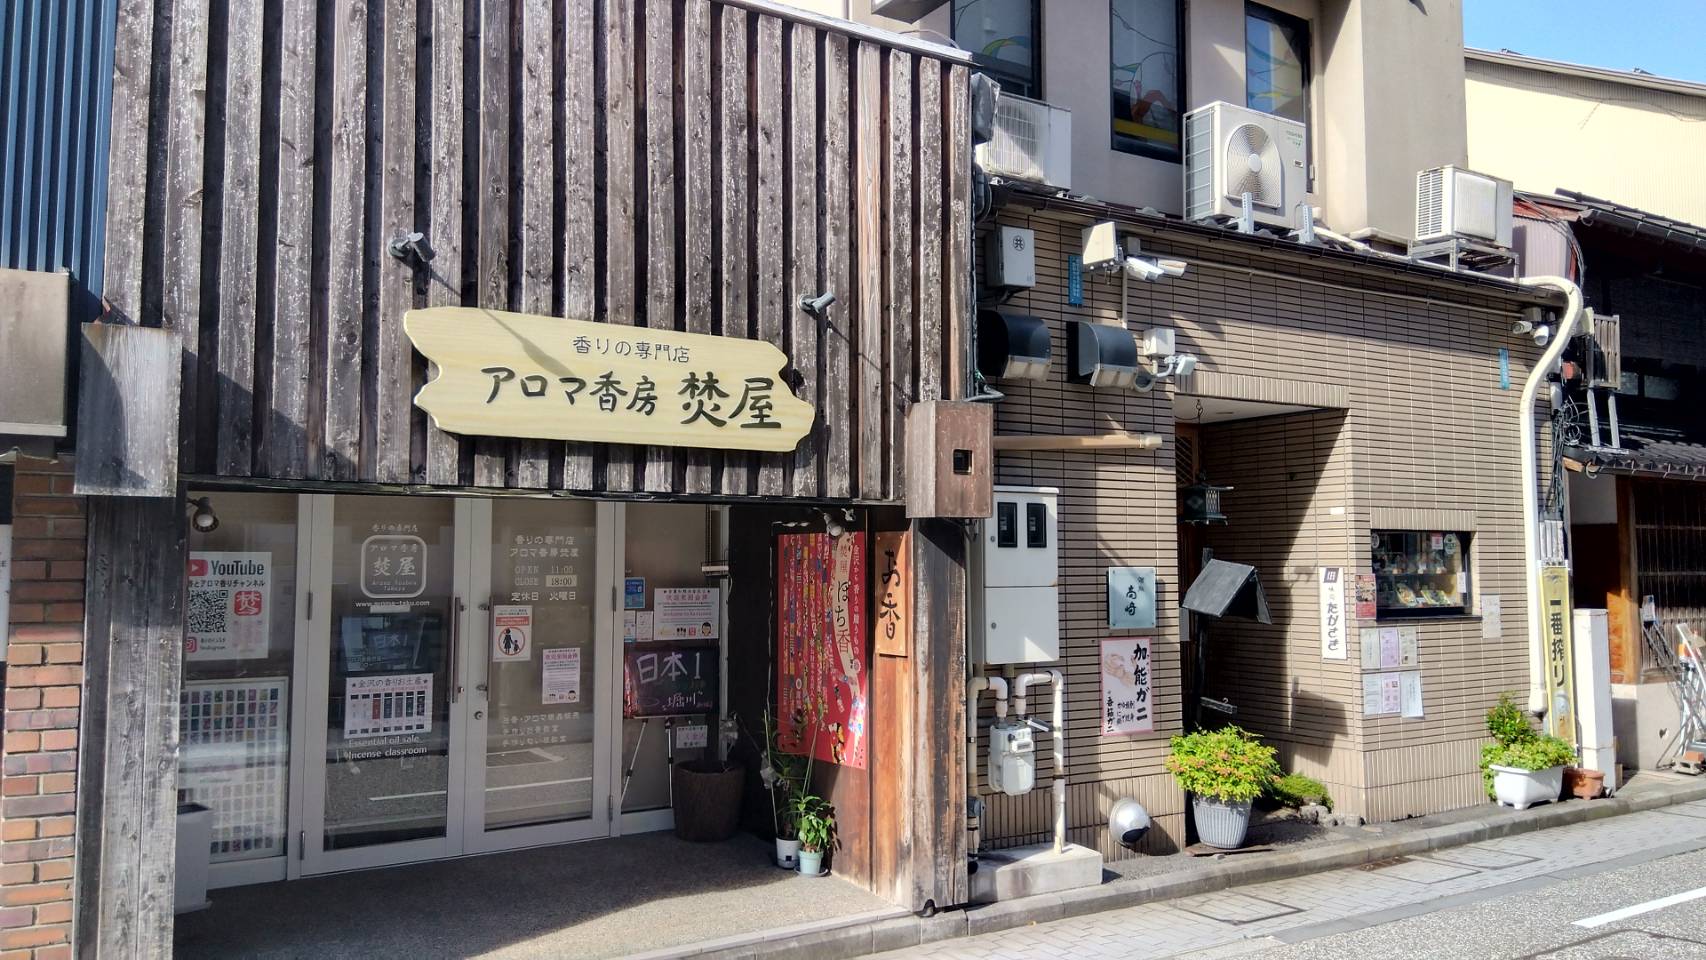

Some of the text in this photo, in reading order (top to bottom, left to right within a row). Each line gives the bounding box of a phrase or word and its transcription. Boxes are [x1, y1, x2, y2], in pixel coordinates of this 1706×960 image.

[573, 335, 690, 363] 香りの専門店
[481, 367, 781, 428] アロマ香房 焚屋
[211, 560, 265, 575] YouTube
[511, 591, 539, 601] 定休日
[880, 549, 901, 641] お香
[1549, 599, 1565, 687] 一番搾り
